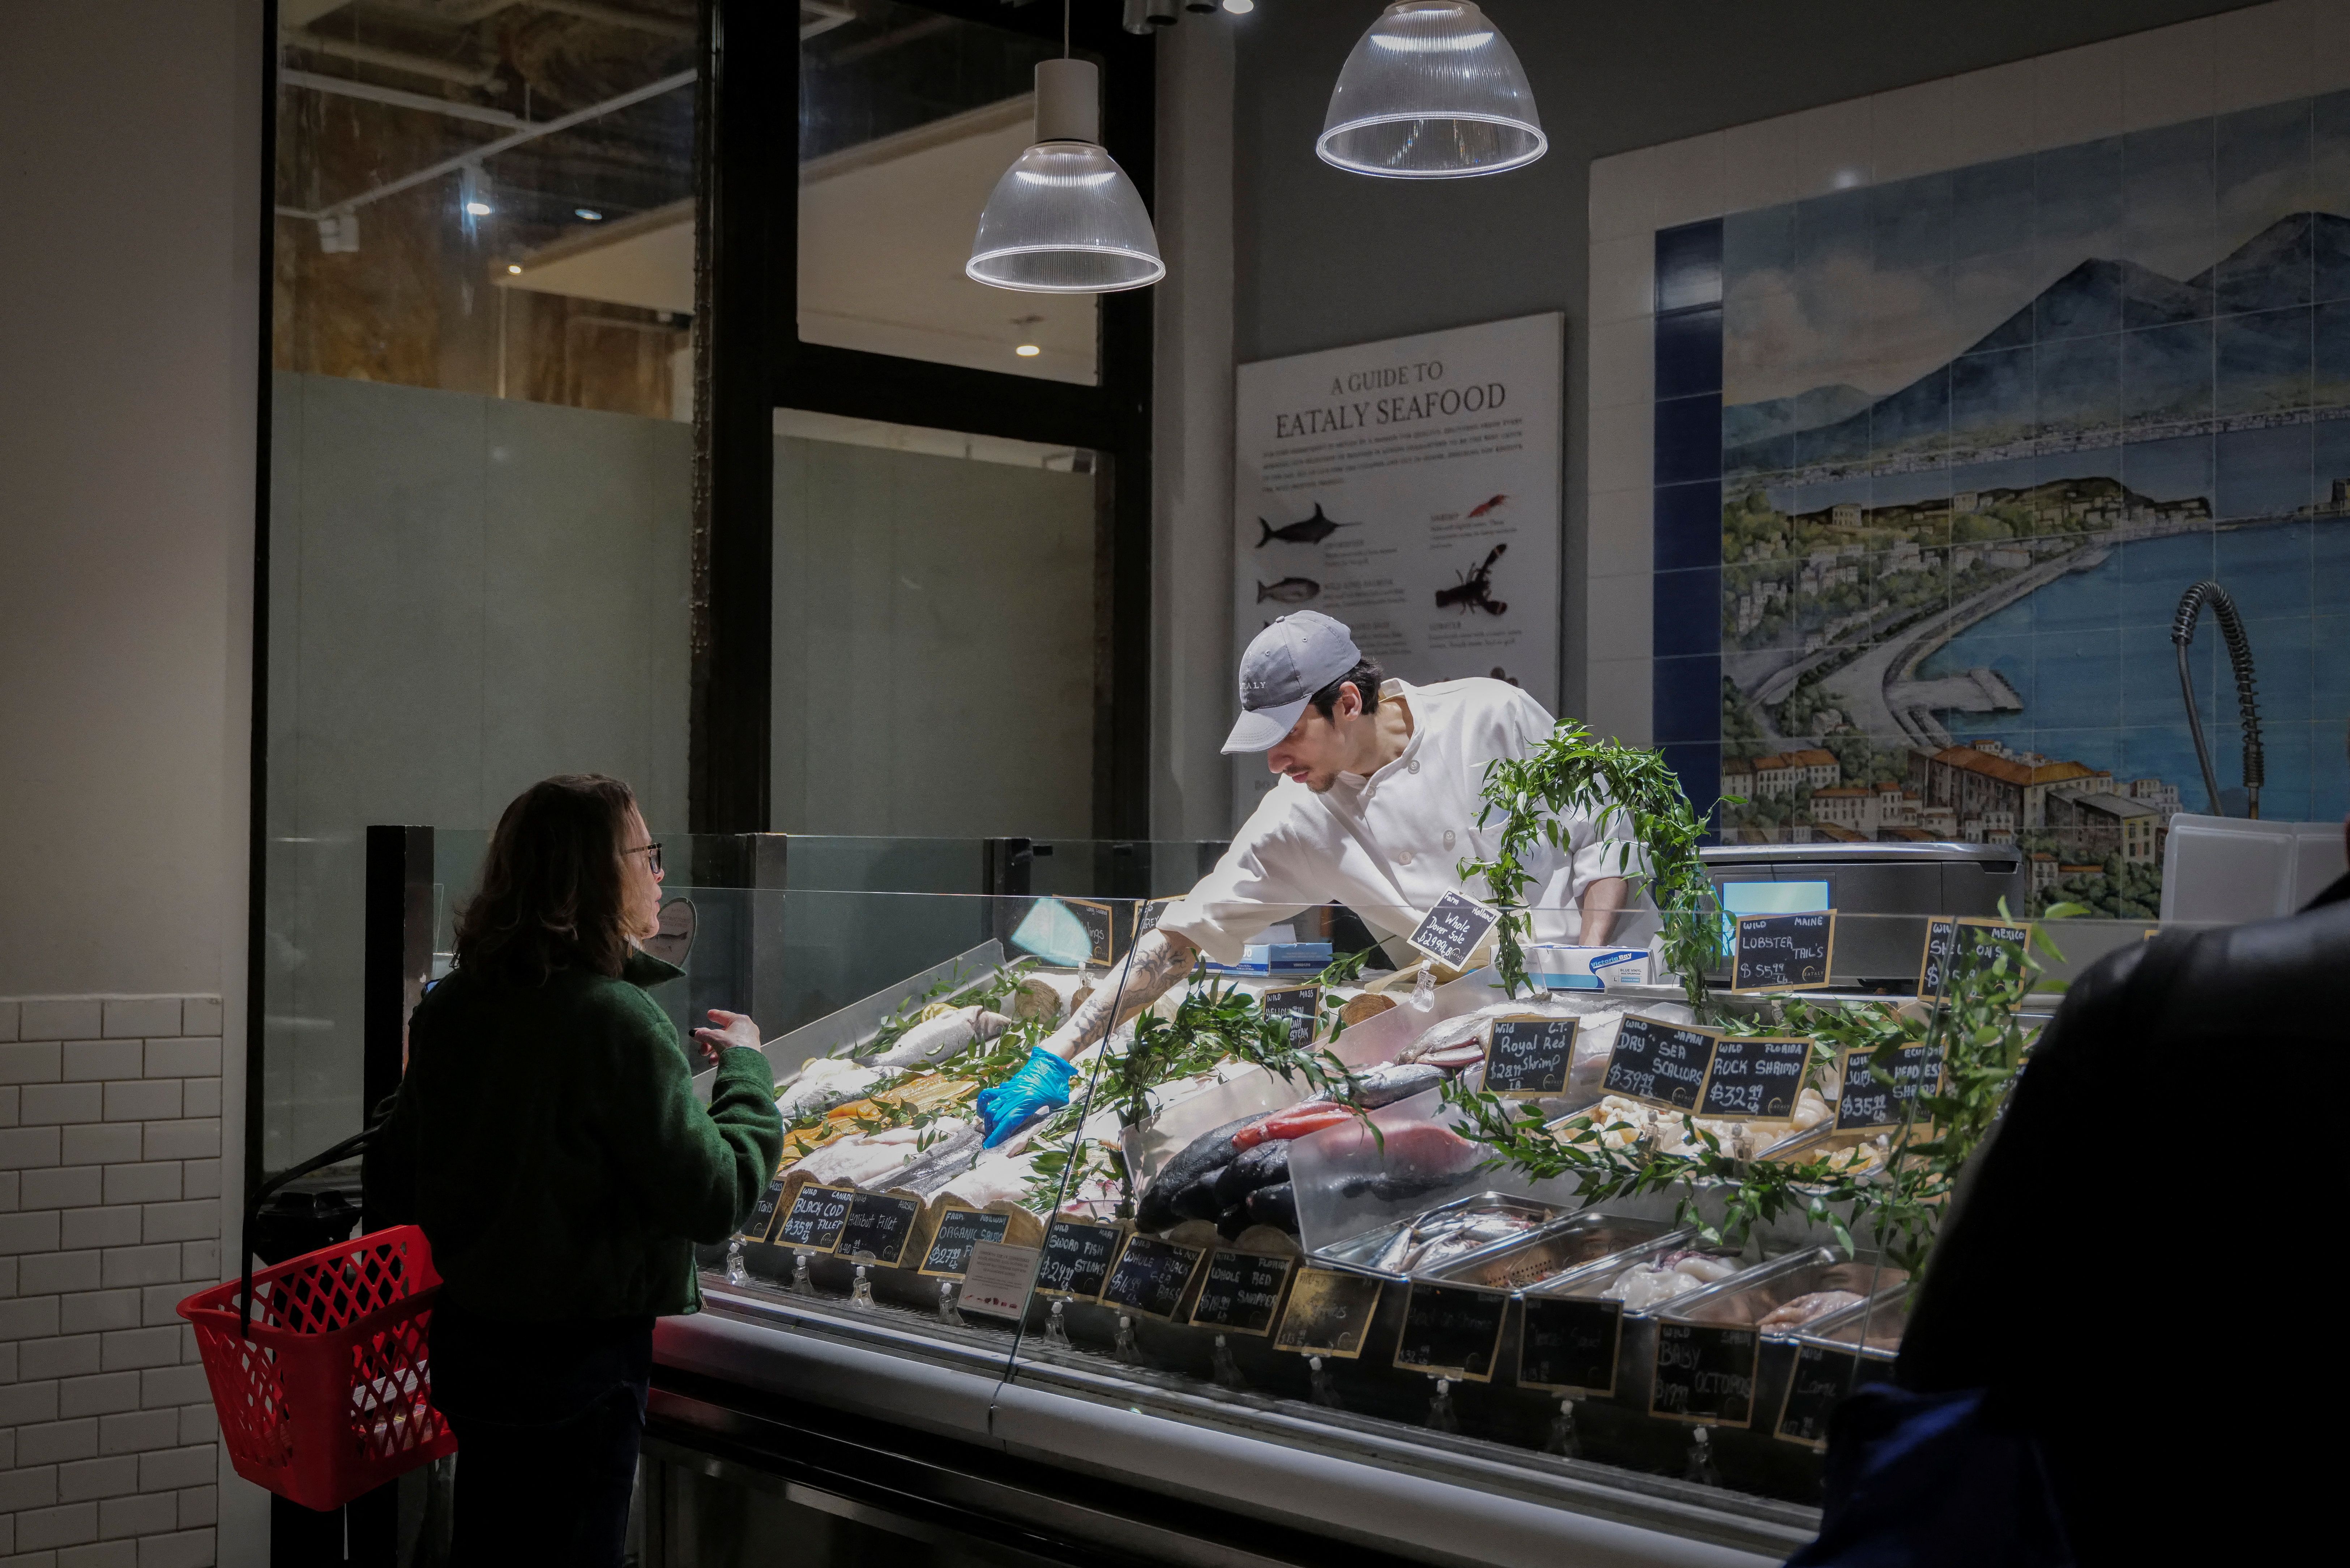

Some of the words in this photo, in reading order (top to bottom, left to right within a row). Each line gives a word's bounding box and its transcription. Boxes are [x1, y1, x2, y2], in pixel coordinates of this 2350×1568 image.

[1331, 378, 1343, 395] A
[1348, 367, 1409, 392] GUIDE
[1414, 361, 1443, 380] TO
[1277, 402, 1370, 438] EATALY
[1377, 383, 1505, 424] SEAFOOD
[1444, 893, 1459, 905] Farm
[1445, 913, 1470, 933] Whole
[1472, 907, 1495, 922] Holland
[1743, 921, 1766, 929] WILD
[1794, 917, 1823, 926] MAINE
[1427, 916, 1448, 934] Dover
[1933, 923, 1951, 933] WIL
[1991, 928, 2025, 940] MEXICO
[1743, 936, 1793, 949] LOBSTER
[1591, 956, 1619, 967] Victoria
[1267, 993, 1281, 1002] WILD
[1299, 990, 1313, 999] MASS
[1290, 1027, 1308, 1041] STEAK
[1495, 1023, 1515, 1033] Wild
[1625, 1020, 1648, 1030] WILD
[1674, 1031, 1703, 1046] JAPAN
[1501, 1034, 1538, 1057] Royal
[1543, 1035, 1565, 1050] Red
[1616, 1032, 1645, 1052] DRY
[1658, 1041, 1686, 1060] SEA
[1718, 1044, 1743, 1053] WILD
[1765, 1044, 1802, 1055] FLORIDA
[1522, 1055, 1561, 1072] Shrimp
[1652, 1058, 1703, 1085] SCALLOPS
[1713, 1058, 1748, 1075] ROCK
[1755, 1060, 1800, 1076] SHRIMP
[759, 1200, 773, 1213] Tails
[793, 1198, 823, 1216] BLACK
[824, 1203, 844, 1217] COD
[817, 1219, 843, 1230] FILLET
[848, 1213, 875, 1229] Halibut
[876, 1214, 897, 1231] Fillet
[945, 1212, 964, 1221] FARM
[980, 1214, 1007, 1225] NORWAY
[939, 1226, 978, 1240] ORGANIC
[1049, 1235, 1079, 1252] SWORD
[1084, 1241, 1104, 1256] FISH
[1131, 1238, 1150, 1249] WILD
[1123, 1250, 1155, 1268] WHOLE
[1074, 1259, 1106, 1277] STEAKS
[1211, 1267, 1241, 1283] WHOLE
[1252, 1271, 1272, 1286] RED
[1150, 1271, 1171, 1284] SEA
[1663, 1327, 1691, 1338] WILD
[1657, 1340, 1701, 1370] BABY
